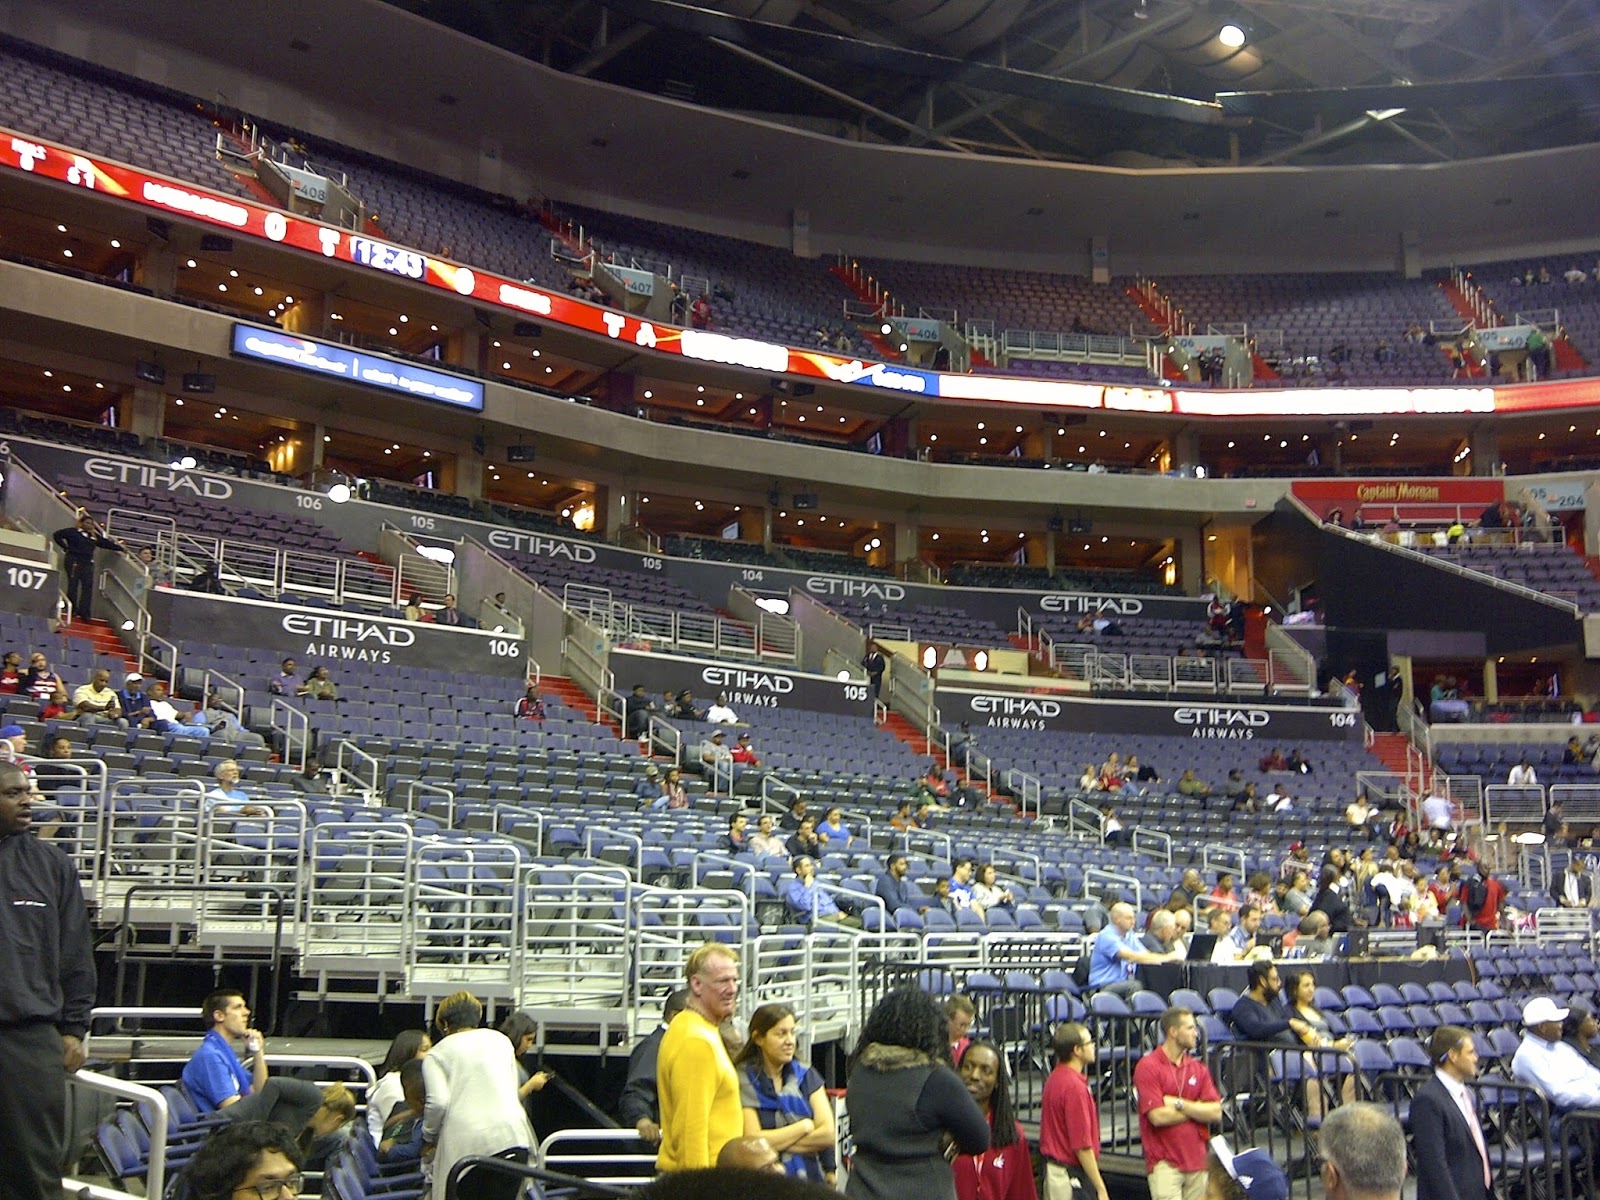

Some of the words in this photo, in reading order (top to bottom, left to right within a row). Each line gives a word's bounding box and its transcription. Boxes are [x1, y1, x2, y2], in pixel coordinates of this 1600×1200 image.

[300, 185, 326, 201] 408
[630, 281, 652, 294] 407
[918, 329, 937, 340] 406
[84, 458, 233, 500] ETIHAD
[1357, 483, 1396, 502] Captain
[1396, 482, 1439, 502] Morgan
[295, 495, 323, 511] 106
[410, 515, 436, 530] 105
[487, 529, 597, 563] ETIHAD
[642, 556, 663, 571] 105
[7, 567, 48, 590] 107
[741, 569, 763, 582] 104
[806, 576, 906, 601] ETIHAD
[1040, 595, 1143, 615] ETIHAD
[282, 613, 416, 648] ETIHAD
[306, 642, 391, 664] AIRWAYS
[488, 639, 519, 658] 106
[702, 666, 794, 694] ETIHAD
[720, 690, 778, 708] AIRWAYS
[843, 685, 868, 701] 105
[970, 695, 1061, 717] ETIHAD
[987, 716, 1046, 731] AIRWAYS
[1173, 708, 1270, 727] ETIHAD
[1329, 713, 1356, 727] 104
[1192, 727, 1254, 740] AIRWAYS
